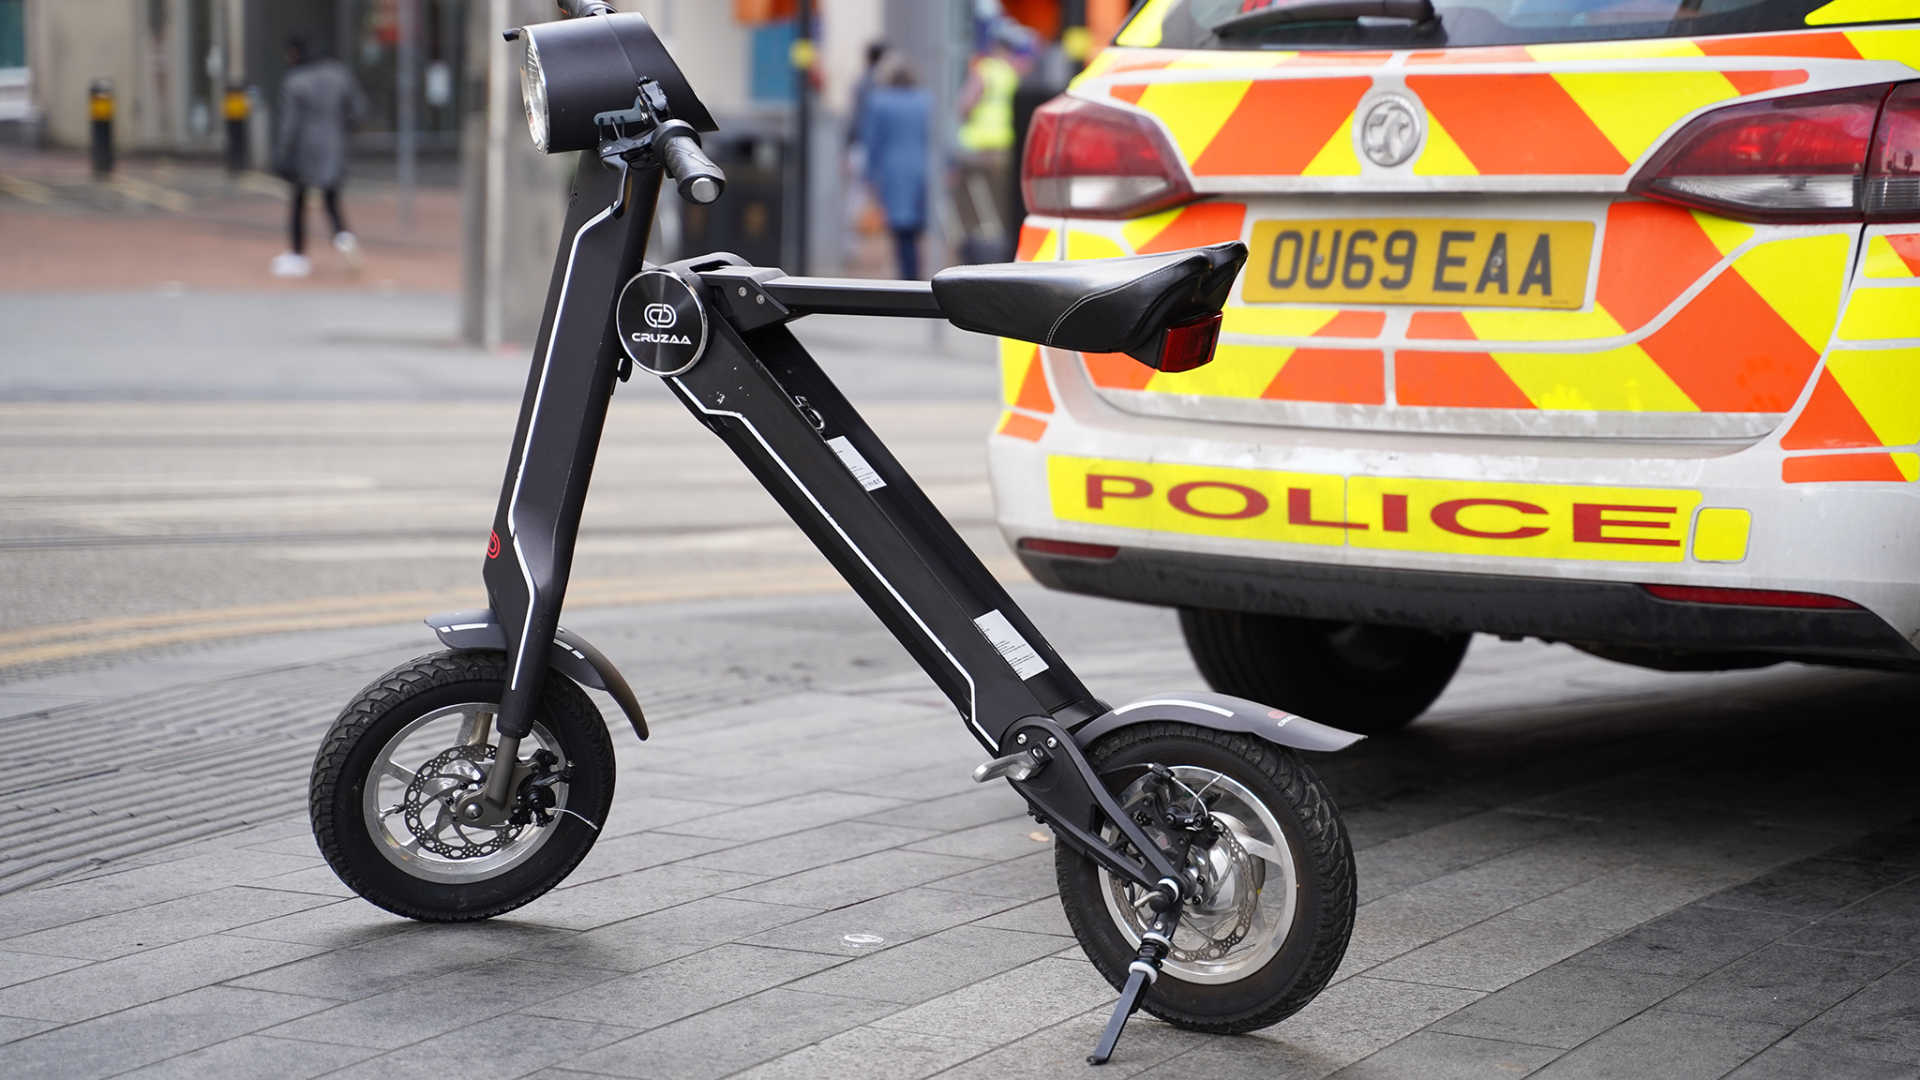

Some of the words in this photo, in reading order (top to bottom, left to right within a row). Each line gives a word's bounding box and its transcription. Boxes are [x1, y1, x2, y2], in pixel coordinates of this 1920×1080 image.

[1268, 229, 1418, 291] OU69
[1432, 230, 1552, 297] EAA
[631, 332, 692, 345] CRUZAA
[1085, 473, 1681, 547] POLICE
